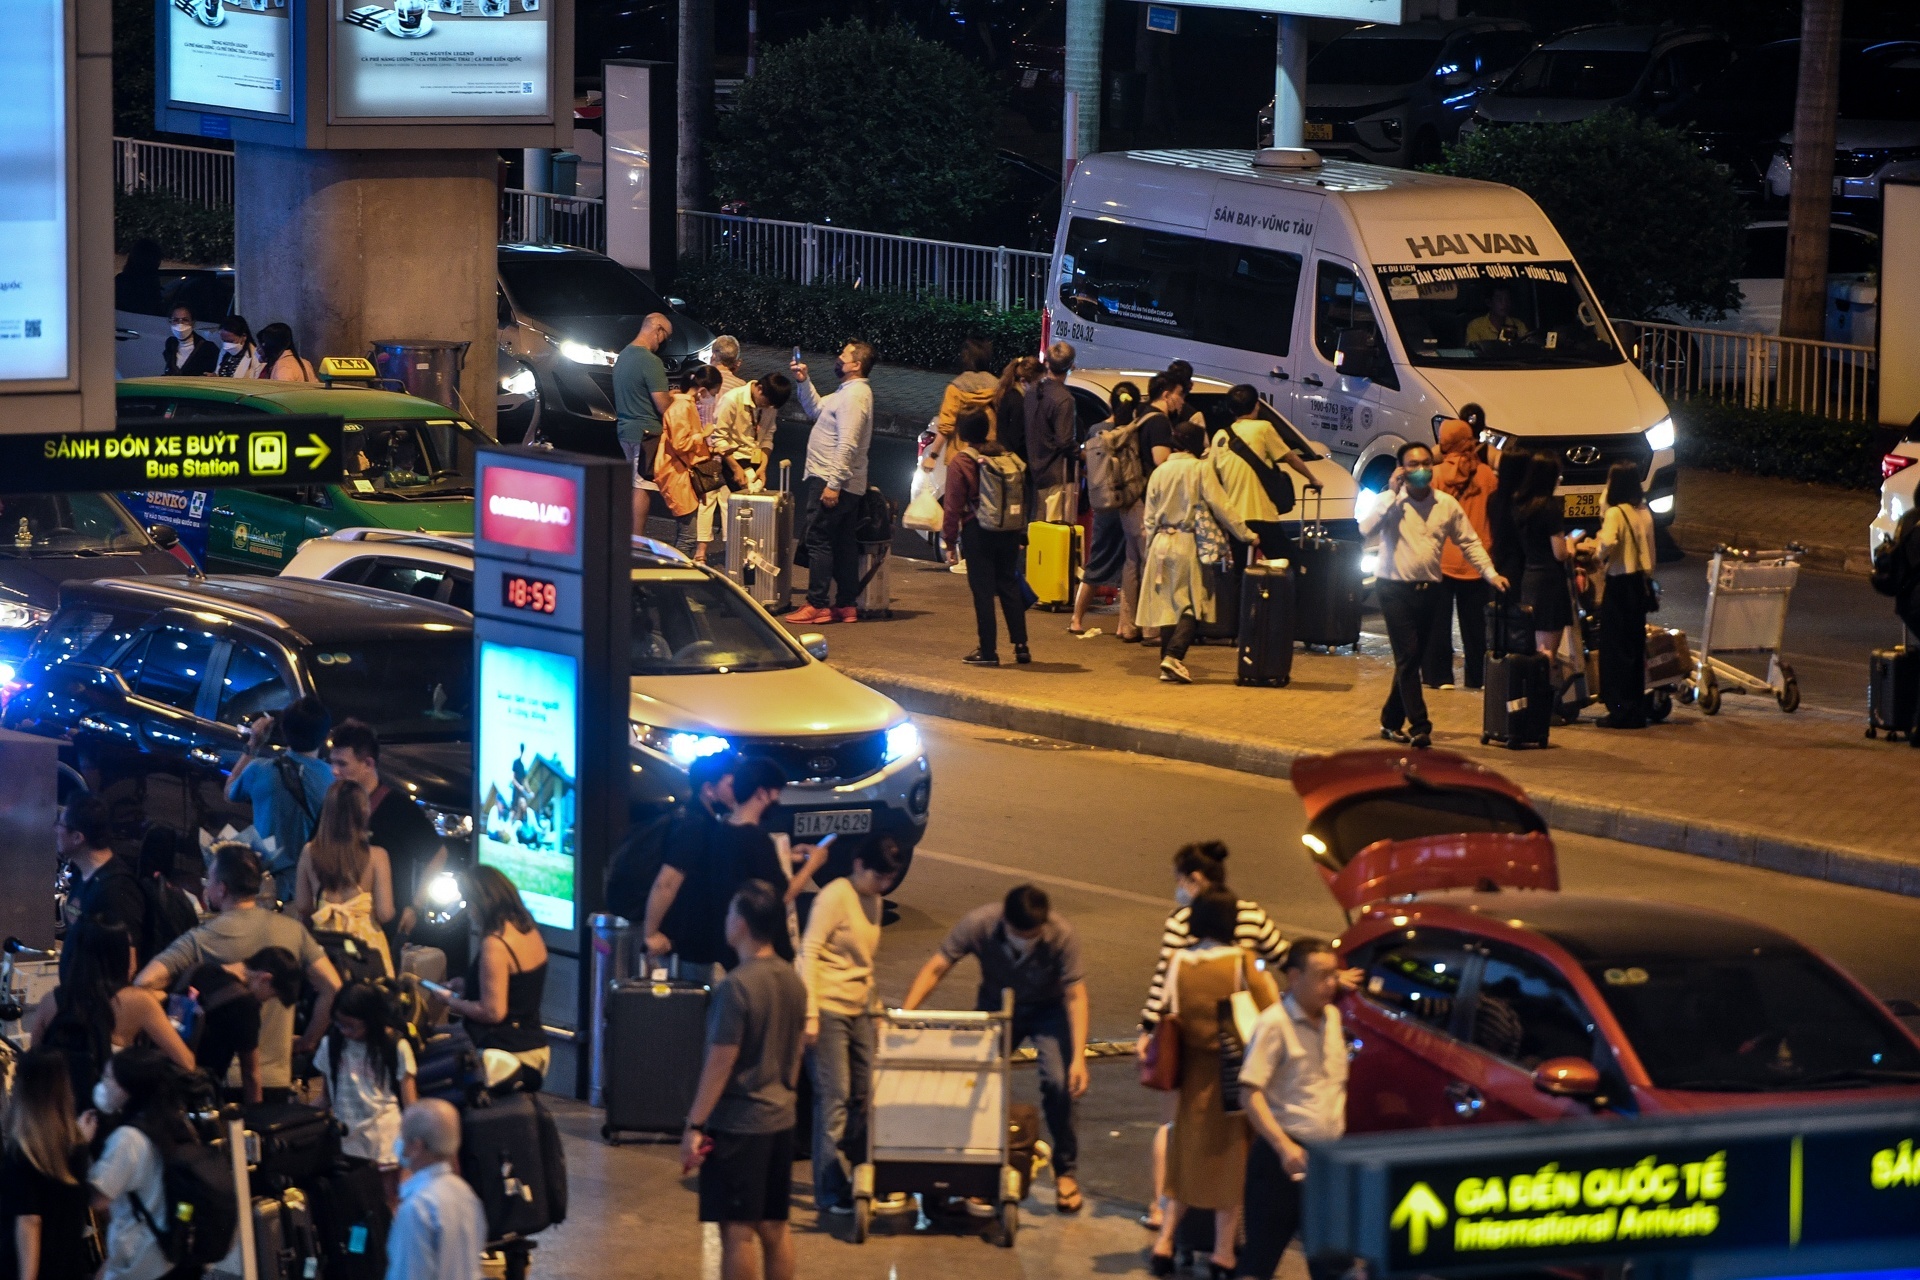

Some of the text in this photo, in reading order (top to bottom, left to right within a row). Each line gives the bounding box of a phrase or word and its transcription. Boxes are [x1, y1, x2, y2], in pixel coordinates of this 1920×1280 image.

[1213, 205, 1235, 223] SÂN
[1293, 218, 1313, 236] TÀU
[1377, 265, 1388, 273] XE
[1411, 269, 1434, 285] TÂN
[1433, 266, 1455, 282] SƠN
[1454, 263, 1480, 279] NHẤT
[1485, 264, 1512, 280] QUẬN
[1512, 266, 1520, 278] 1
[1524, 265, 1551, 281] VŨNG
[1549, 268, 1568, 284] TÀU
[330, 359, 367, 369] TAXI
[44, 430, 240, 460] SẢNH ĐÓN XE BUÝT
[146, 458, 240, 479] Bus Station
[146, 490, 188, 510] SENKO
[1568, 506, 1600, 516] 624.32
[1576, 495, 1594, 505] 29B
[540, 503, 570, 525] LAND
[508, 578, 557, 614] 18:59
[1454, 1176, 1508, 1216] GA
[1454, 1199, 1721, 1252] International Arrivals
